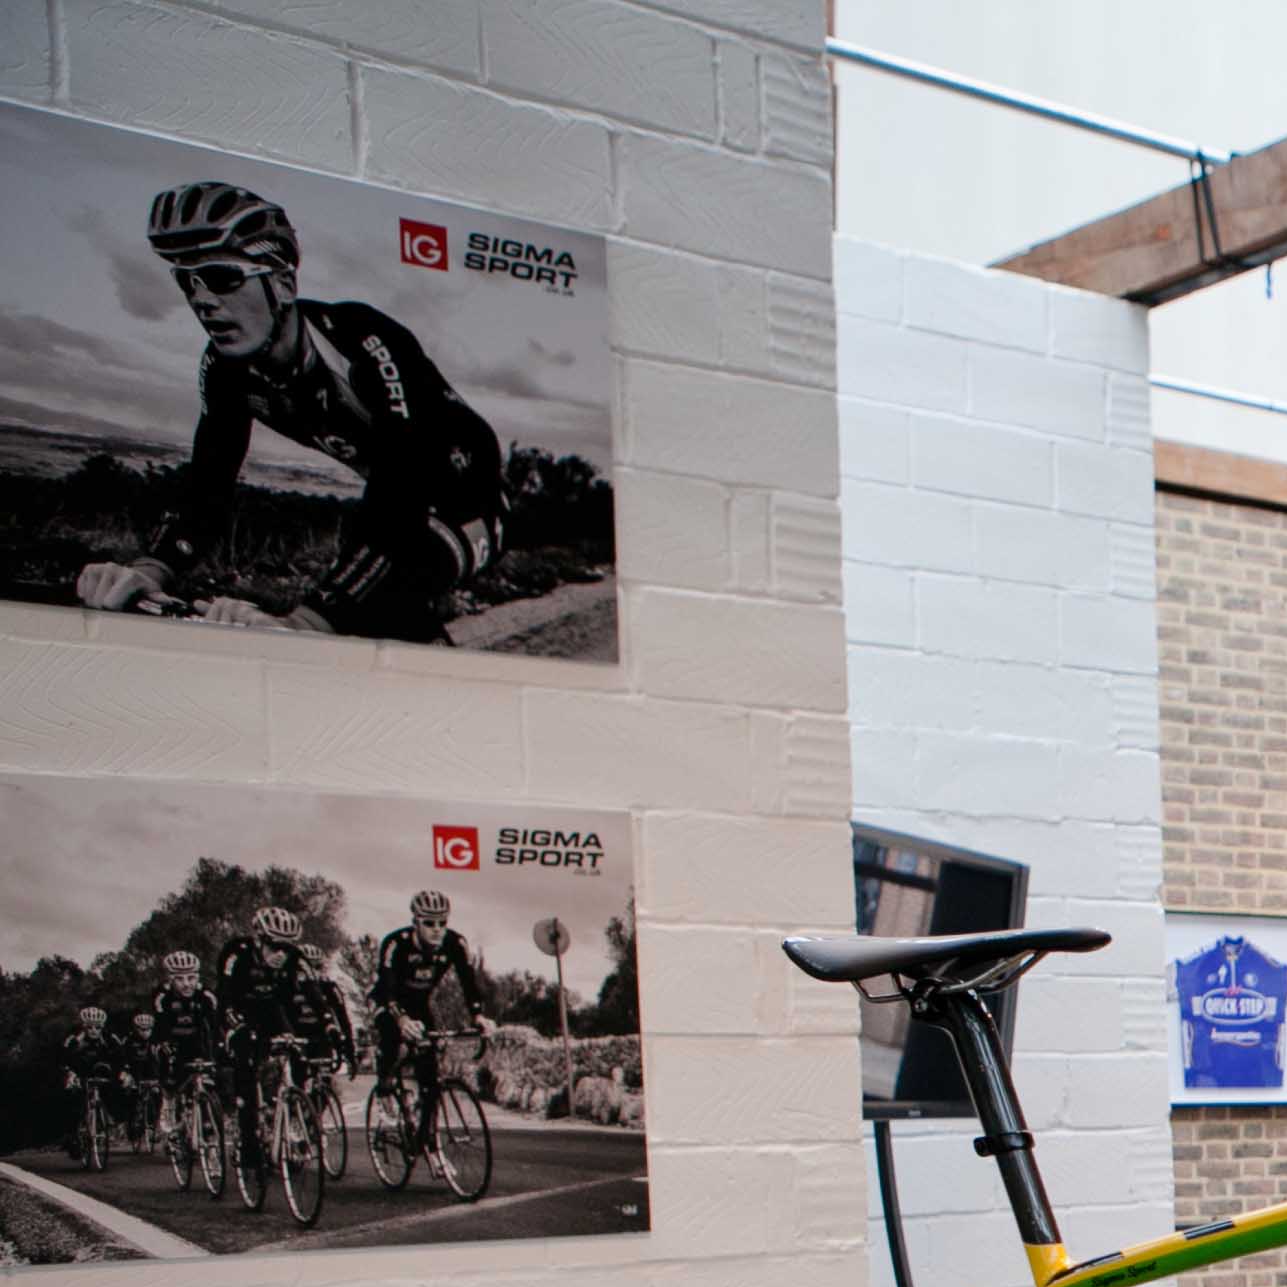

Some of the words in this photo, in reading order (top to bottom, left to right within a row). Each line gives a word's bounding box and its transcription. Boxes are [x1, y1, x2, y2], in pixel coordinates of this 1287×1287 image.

[403, 231, 442, 265] IG
[467, 232, 576, 270] SIGMA
[463, 252, 578, 288] SPORT
[362, 334, 409, 419] SPORT
[436, 836, 474, 867] IG
[498, 828, 602, 849] SIGMA
[495, 848, 604, 868] SPORT
